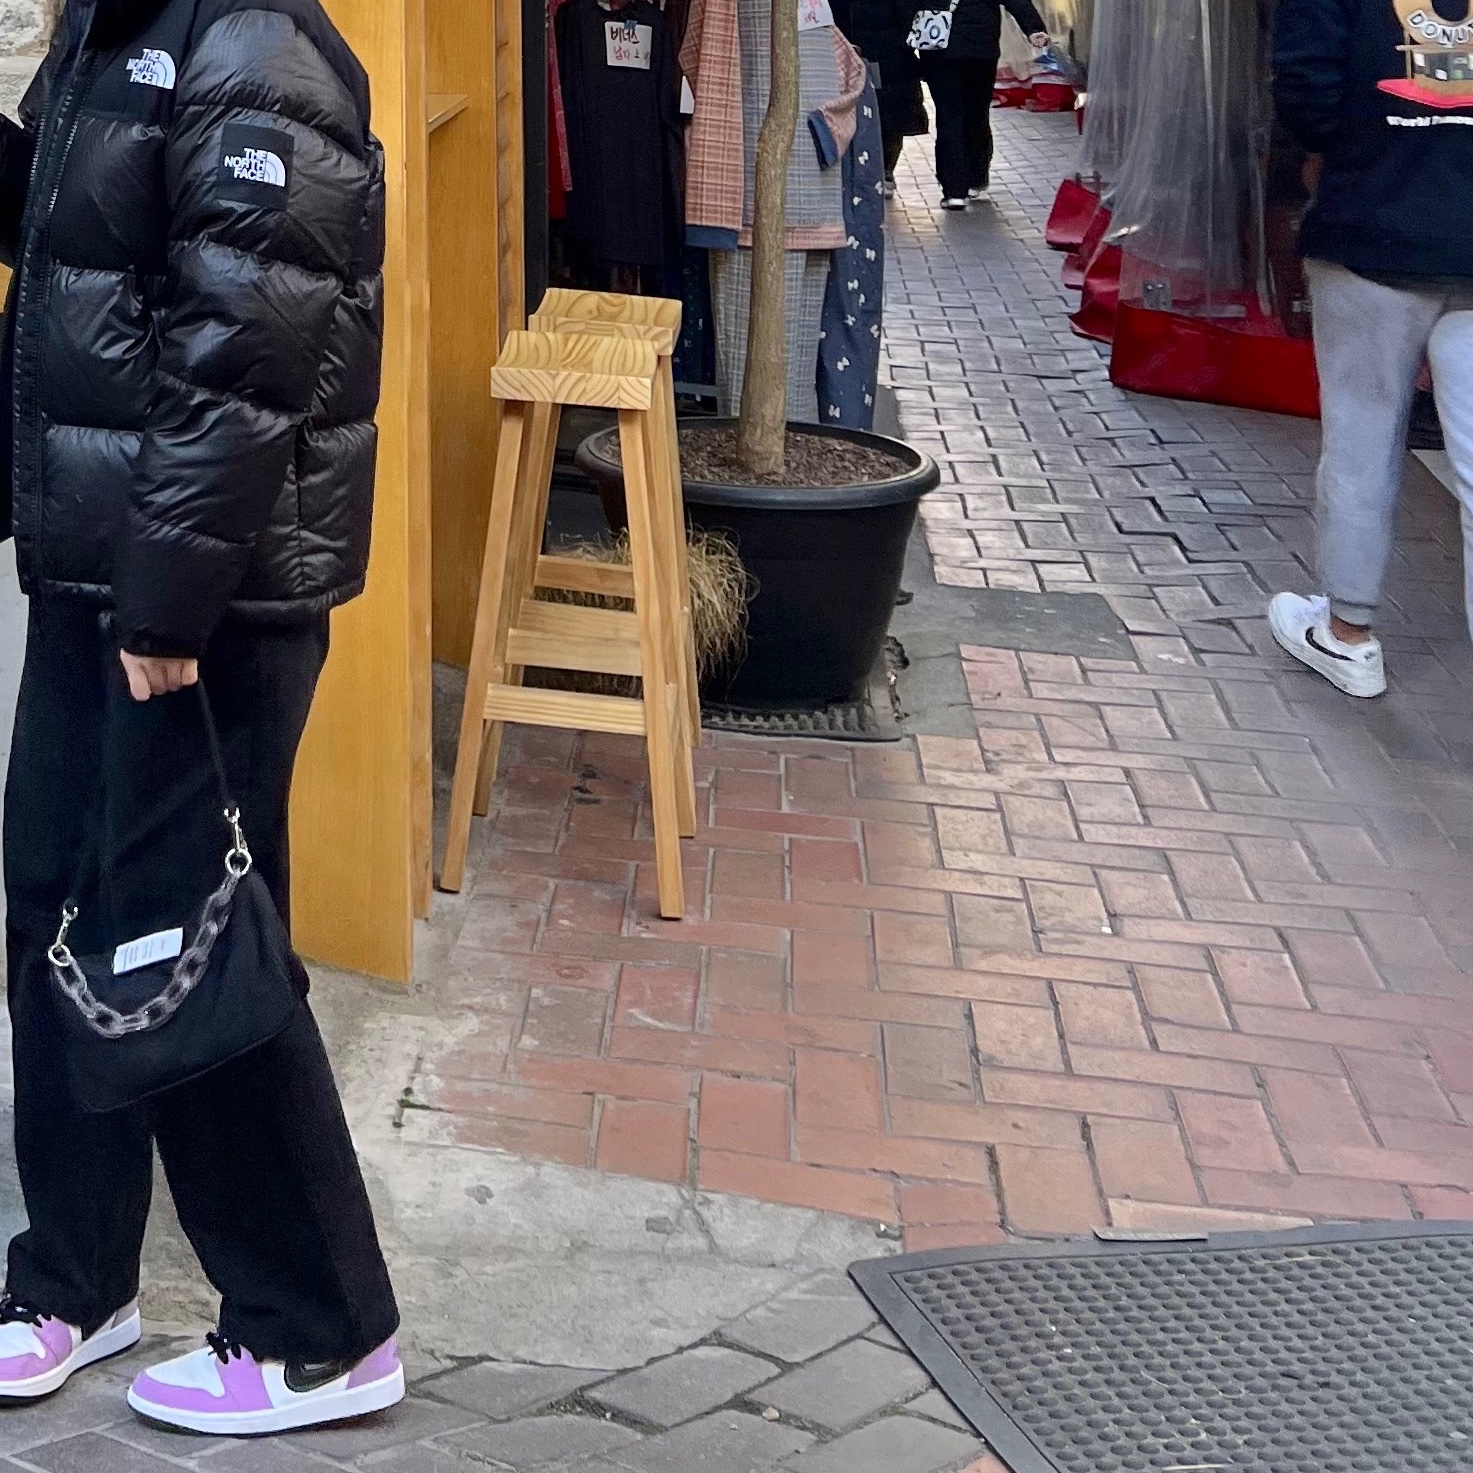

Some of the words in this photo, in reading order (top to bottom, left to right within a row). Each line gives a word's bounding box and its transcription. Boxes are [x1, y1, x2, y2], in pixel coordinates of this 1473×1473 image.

[142, 48, 161, 60] THE
[130, 69, 154, 85] FACE
[244, 147, 268, 160] THE
[224, 155, 266, 171] NORTH
[233, 167, 265, 182] FACE
